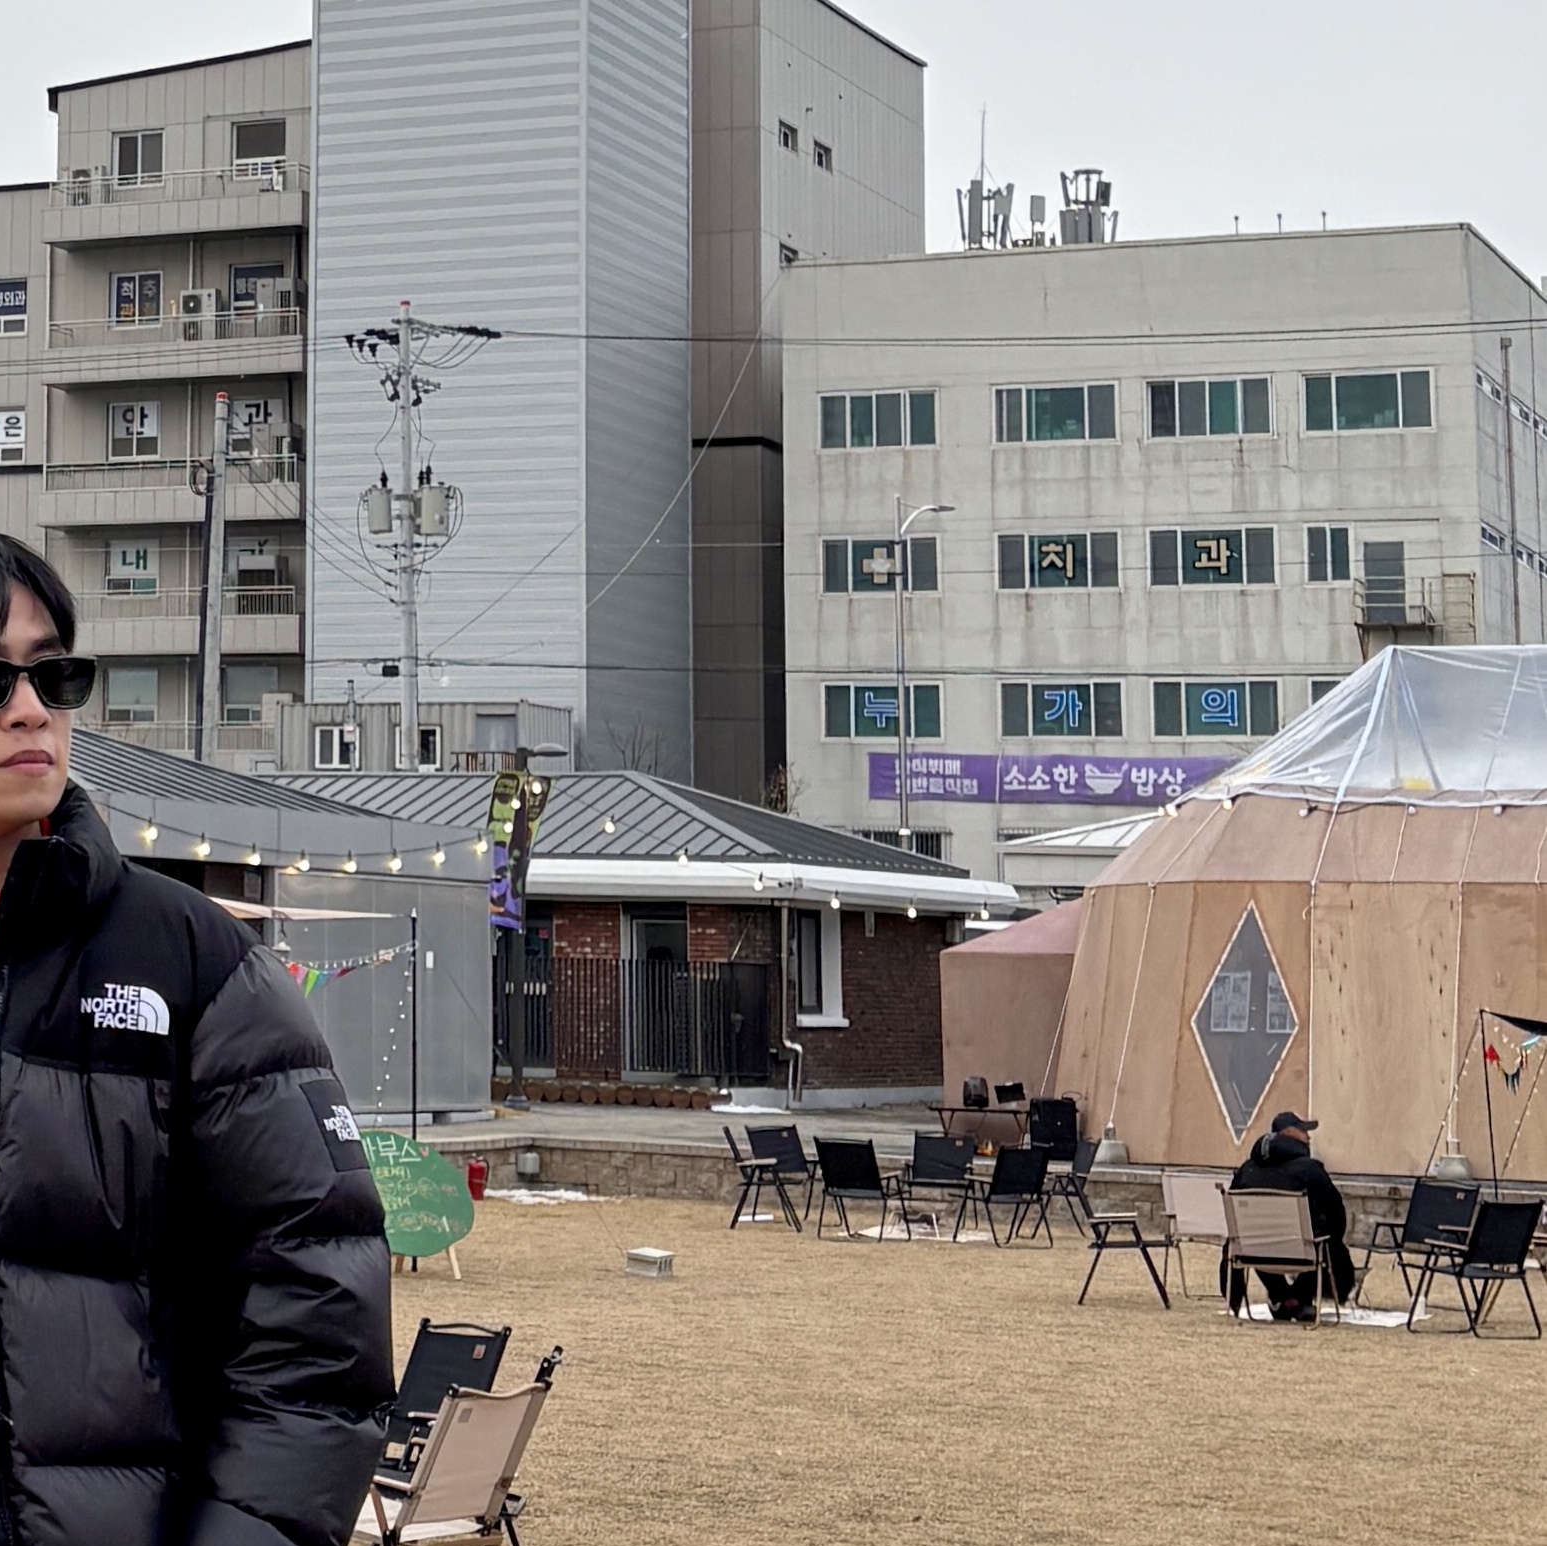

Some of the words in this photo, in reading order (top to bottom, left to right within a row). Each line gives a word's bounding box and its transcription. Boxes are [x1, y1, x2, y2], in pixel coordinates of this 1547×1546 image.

[122, 405, 148, 436] 안
[243, 400, 273, 427] 과
[1039, 542, 1074, 579] 치
[1194, 537, 1233, 576] 과
[862, 691, 900, 729] 누
[1043, 689, 1083, 728] 가
[1200, 687, 1239, 727] 의
[1004, 763, 1079, 794] 소소한
[1130, 764, 1187, 797] 밥상
[80, 997, 138, 1015] NORTH
[103, 982, 141, 1001] THE
[94, 1011, 138, 1031] FACE
